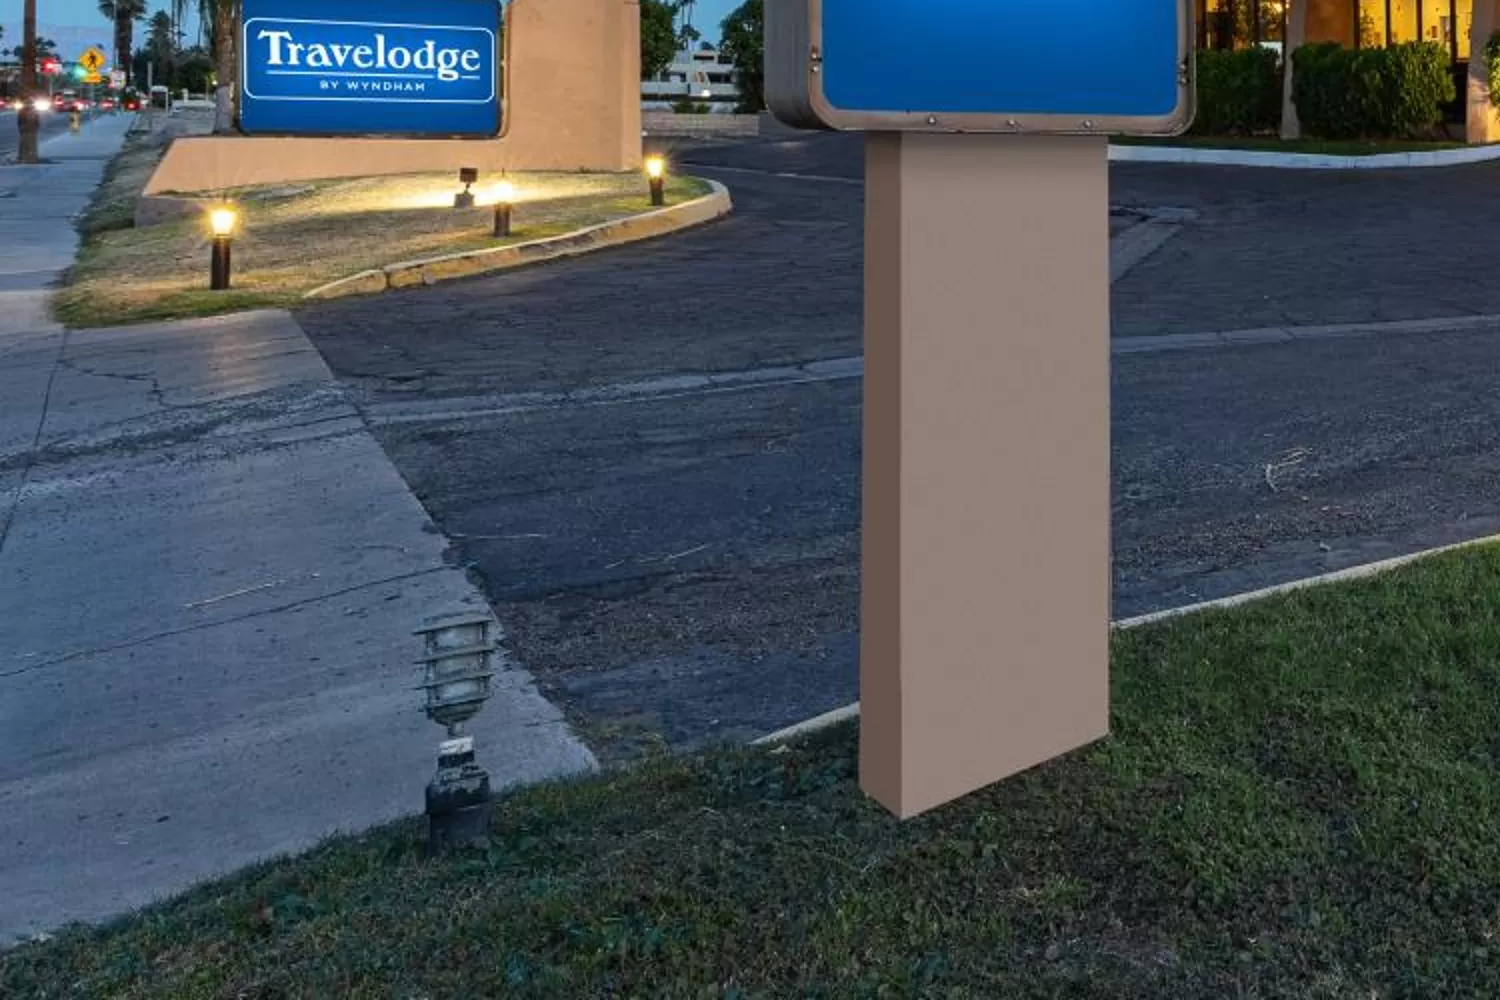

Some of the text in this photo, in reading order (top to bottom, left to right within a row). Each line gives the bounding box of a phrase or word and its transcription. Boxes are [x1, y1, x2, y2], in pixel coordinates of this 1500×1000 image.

[258, 29, 481, 81] Travelodge
[320, 80, 426, 92] BY WYNDHAM
